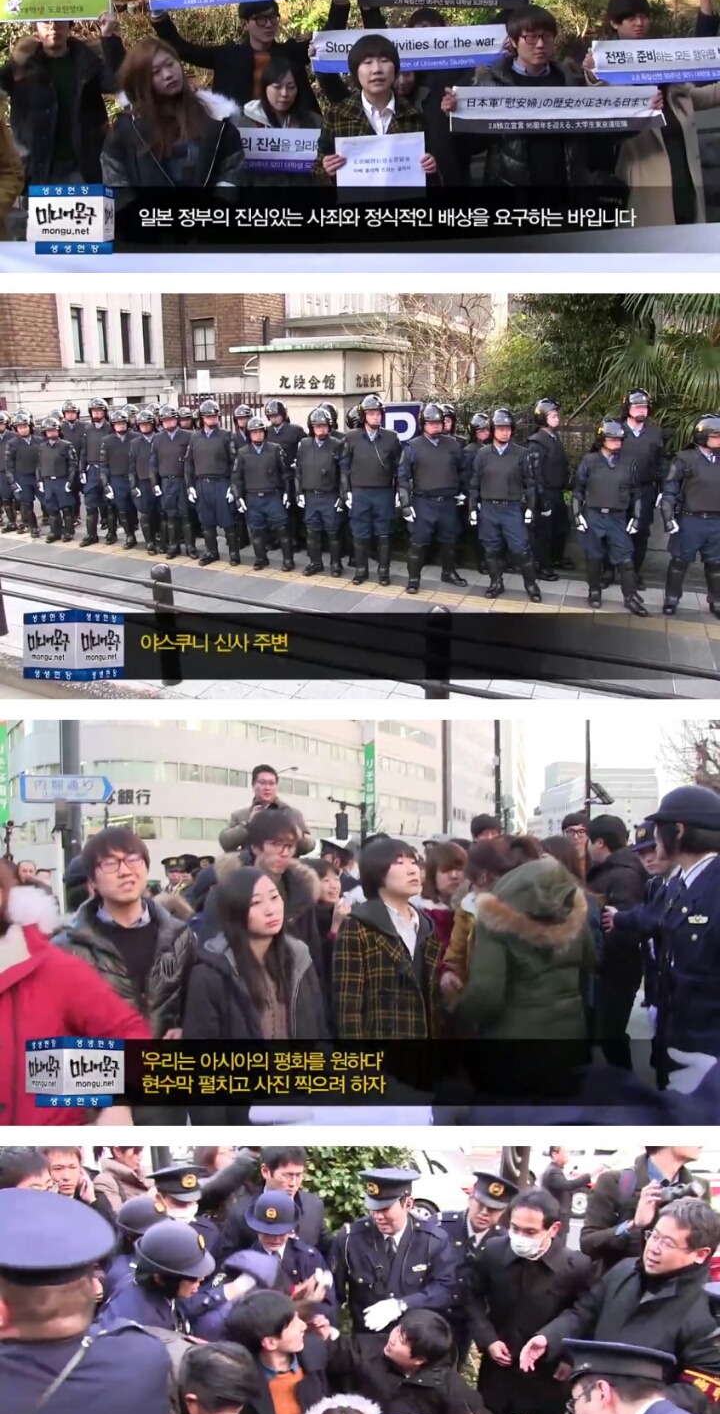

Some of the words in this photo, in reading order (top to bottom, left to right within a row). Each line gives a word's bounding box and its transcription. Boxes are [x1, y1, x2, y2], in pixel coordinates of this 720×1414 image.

[325, 41, 351, 56] Stop
[393, 39, 429, 51] tivities
[433, 38, 449, 50] for
[453, 37, 472, 49] the
[475, 38, 495, 47] war
[605, 50, 635, 65] 전쟁을
[636, 49, 673, 63] 준비하는
[674, 50, 691, 62] 모든
[692, 48, 717, 61] 행위를
[256, 137, 292, 152] 진실을
[384, 411, 417, 442] P
